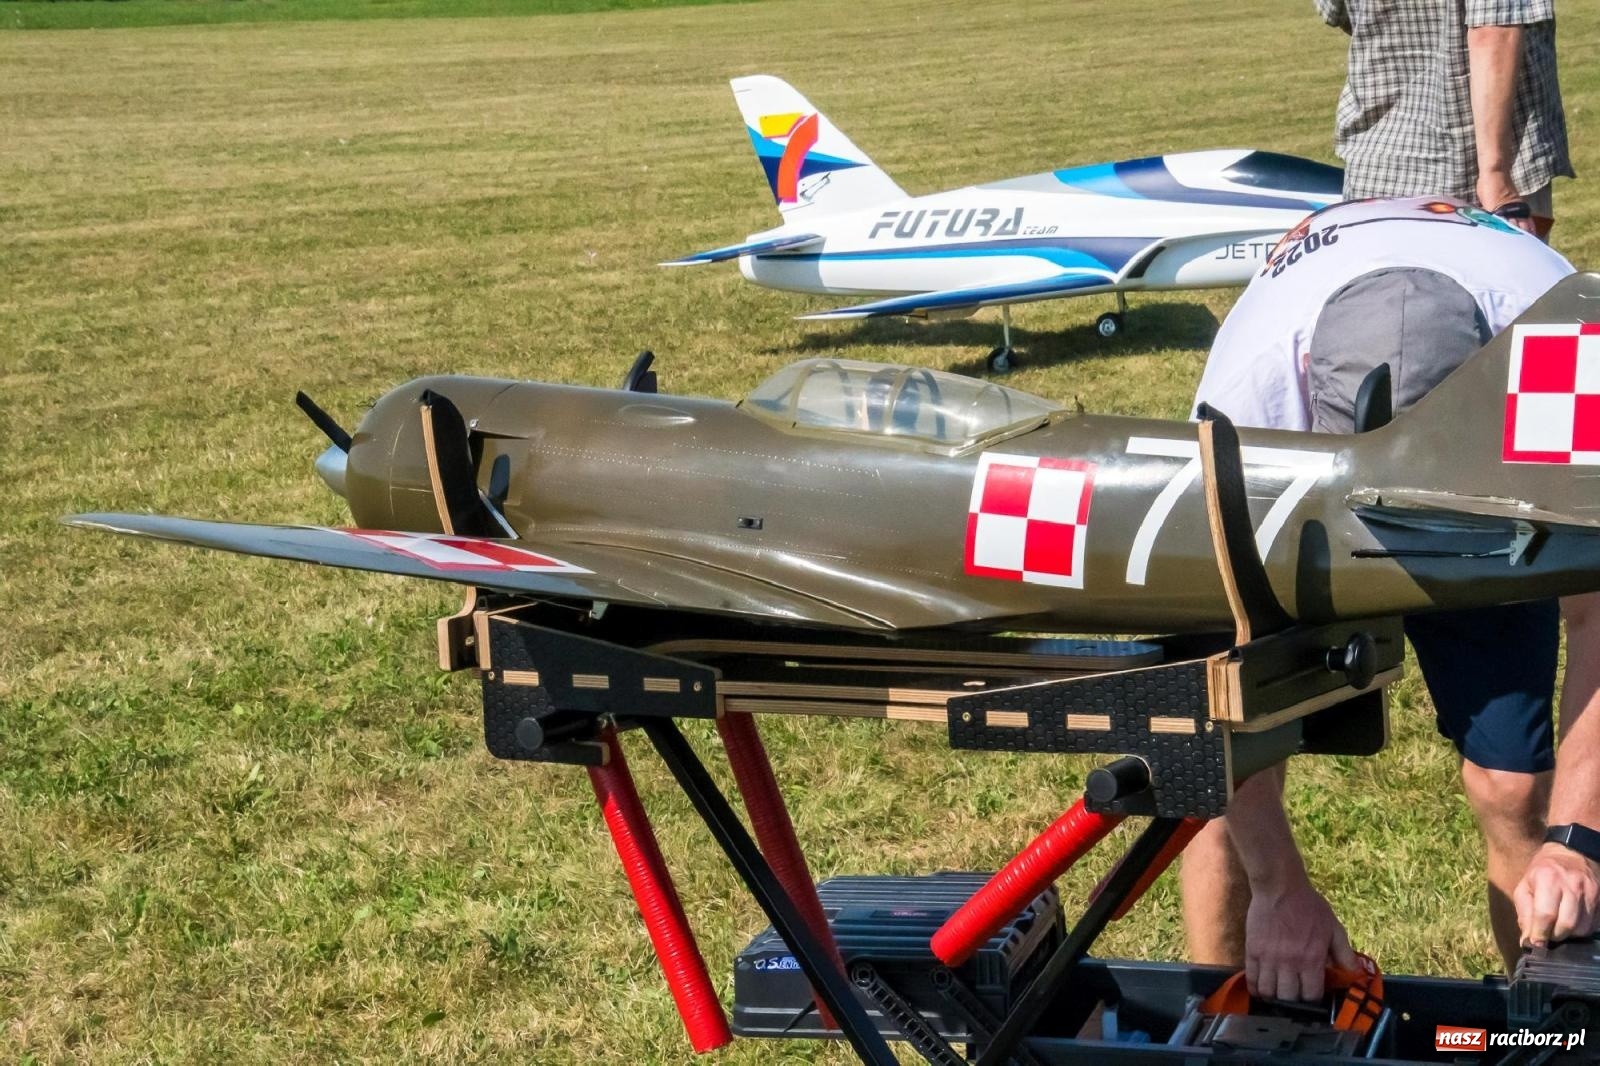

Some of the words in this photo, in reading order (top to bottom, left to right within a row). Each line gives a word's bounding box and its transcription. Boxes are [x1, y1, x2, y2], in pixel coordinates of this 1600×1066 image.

[868, 206, 1025, 239] FUTURA
[1271, 223, 1339, 279] 2022
[1126, 436, 1336, 586] 77
